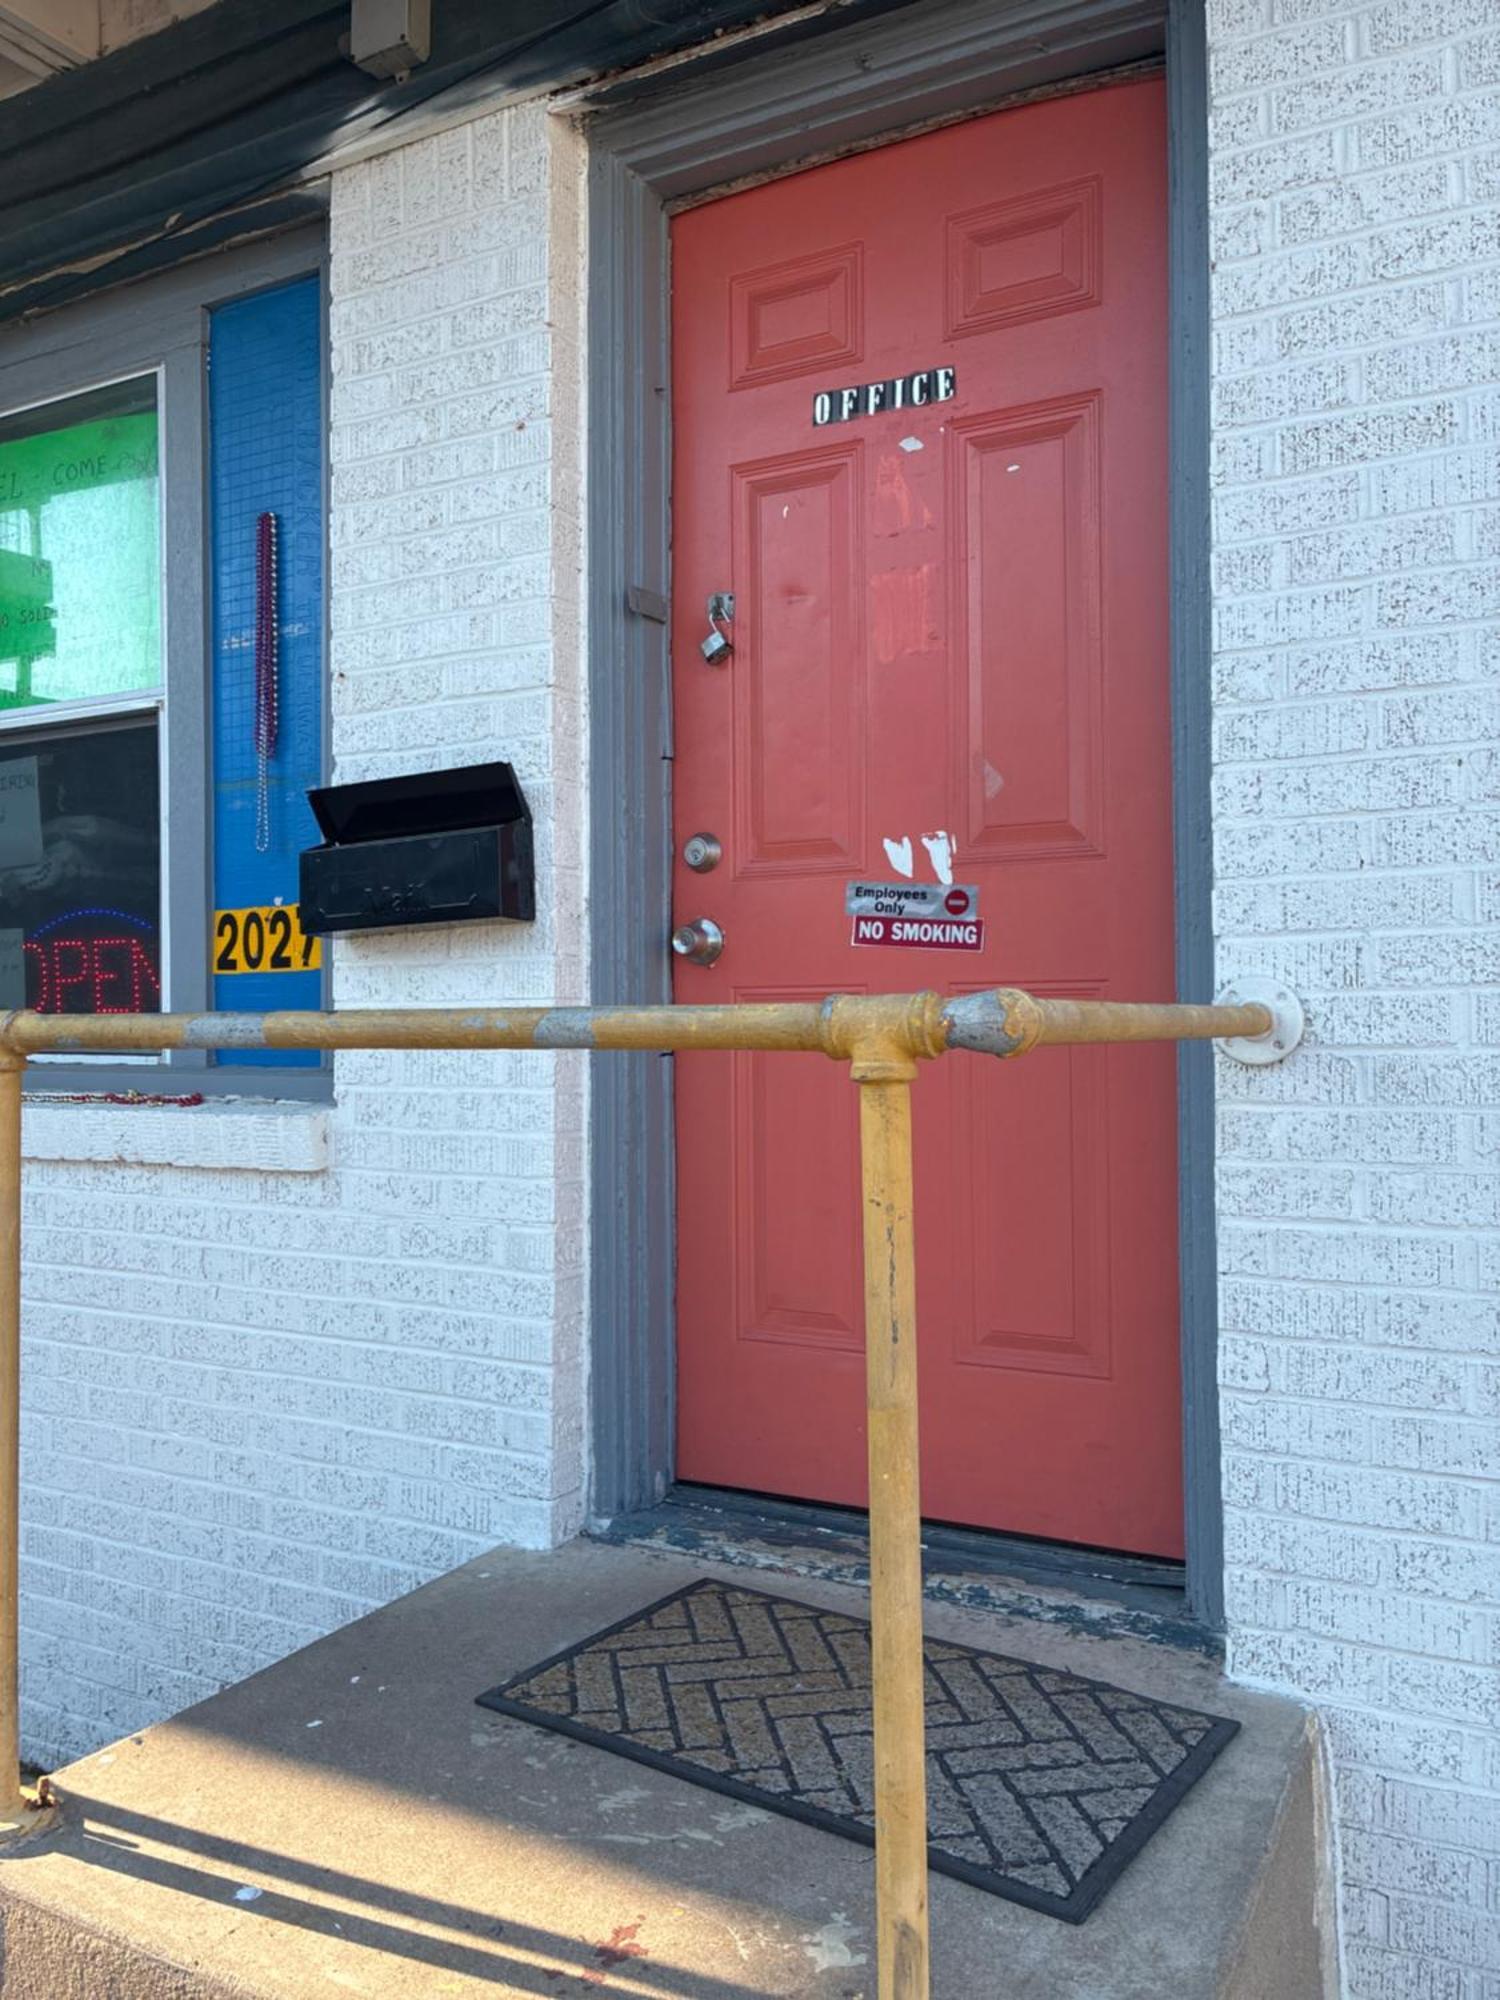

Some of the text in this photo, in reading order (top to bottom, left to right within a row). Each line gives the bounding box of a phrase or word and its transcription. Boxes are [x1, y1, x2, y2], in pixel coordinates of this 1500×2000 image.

[814, 367, 955, 425] OFFICE
[52, 454, 108, 486] COME
[855, 886, 928, 901] Employees
[874, 901, 905, 916] Only
[858, 920, 978, 944] NO SMOKING
